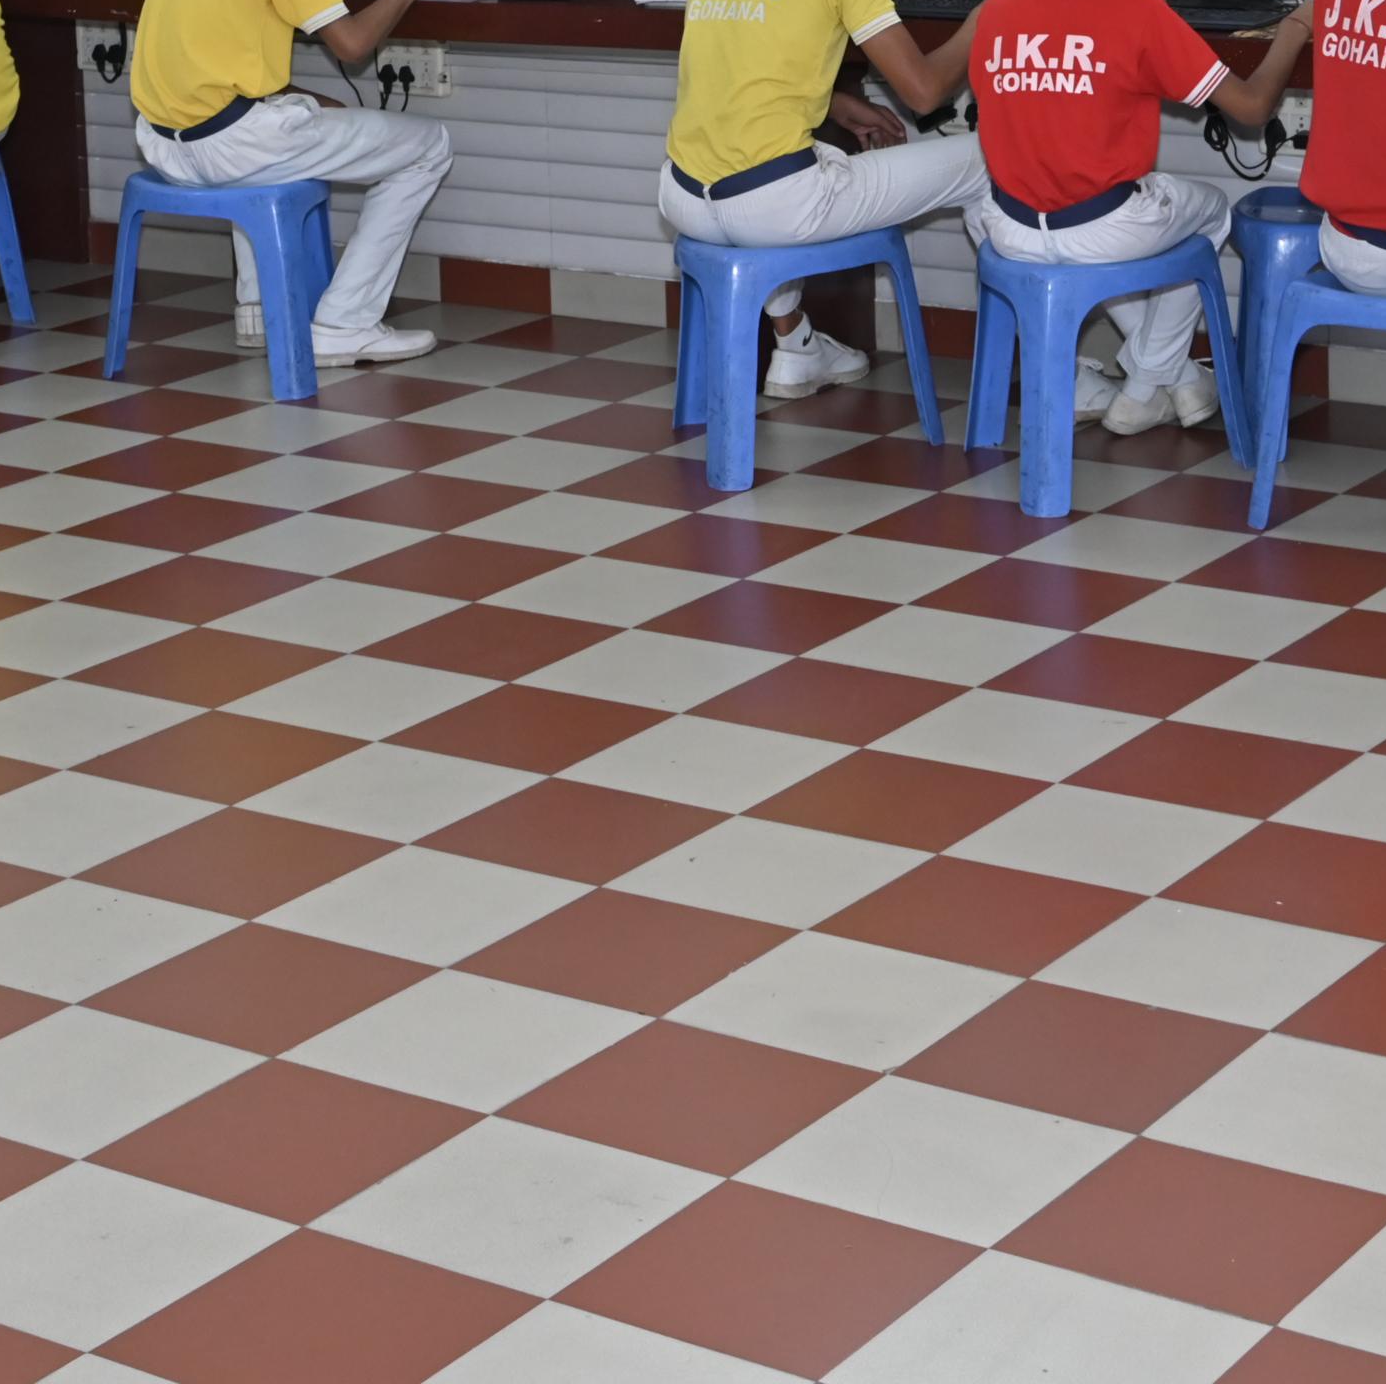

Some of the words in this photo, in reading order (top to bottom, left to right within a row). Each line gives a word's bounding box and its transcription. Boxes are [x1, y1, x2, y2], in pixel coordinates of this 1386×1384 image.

[688, 0, 766, 24] GOHANA
[984, 34, 1107, 74] J.K.R.
[993, 71, 1094, 96] GOHANA
